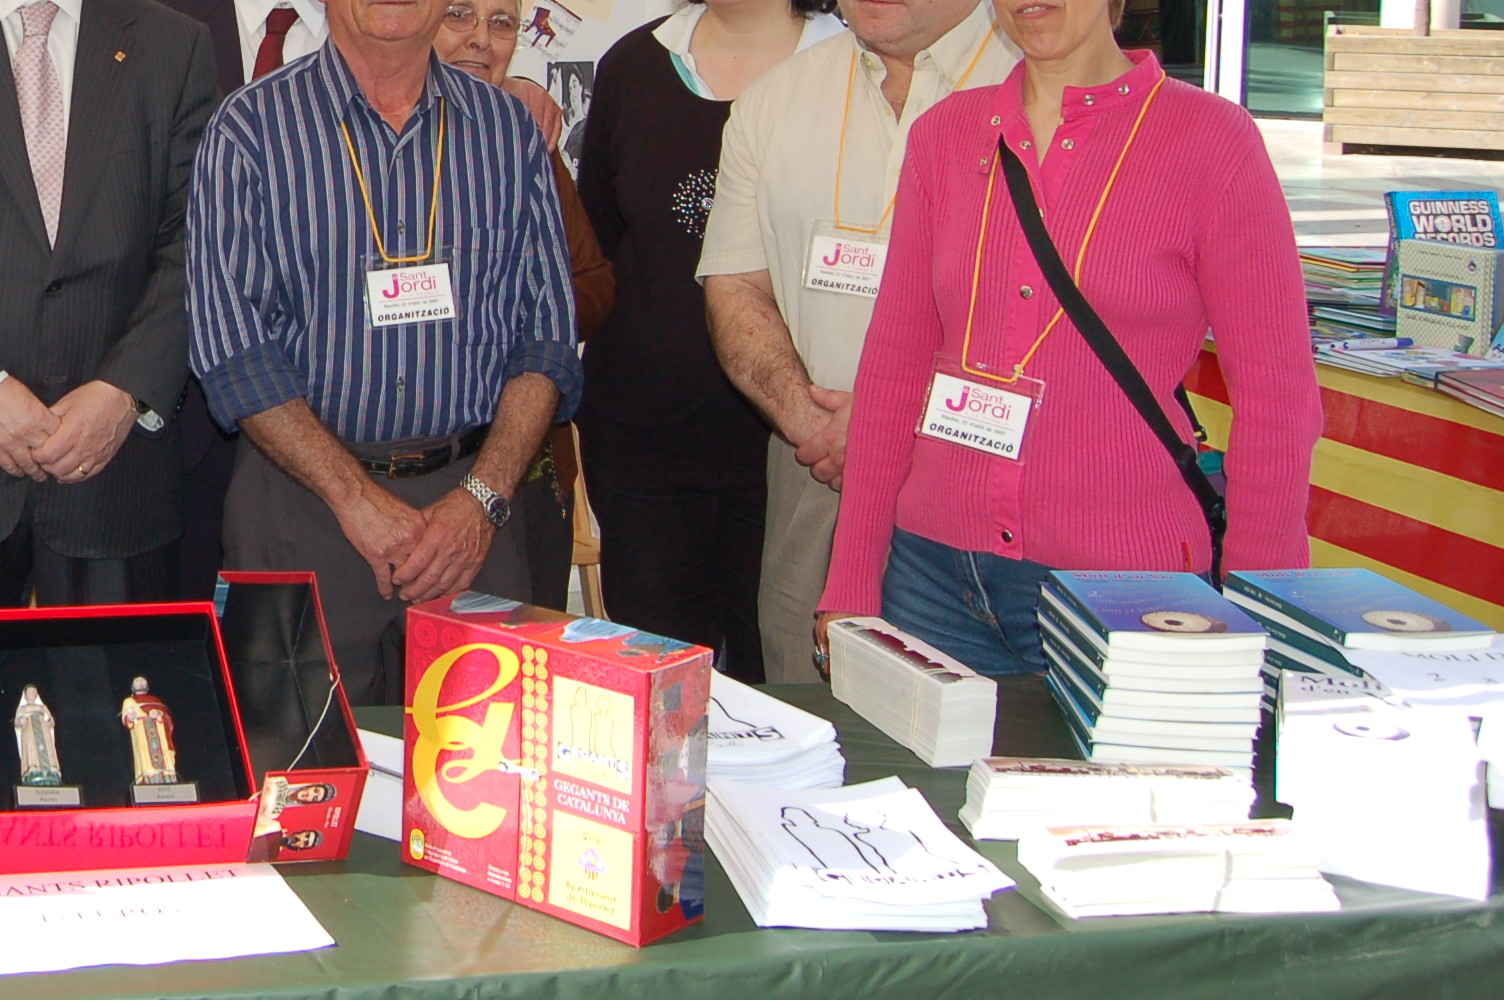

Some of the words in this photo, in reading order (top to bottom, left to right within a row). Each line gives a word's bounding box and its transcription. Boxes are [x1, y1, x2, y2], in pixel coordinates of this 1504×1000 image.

[1408, 200, 1490, 214] GUINNESS
[1411, 214, 1494, 233] WORLD
[822, 242, 876, 268] Jordi
[842, 243, 870, 255] Sant
[382, 273, 437, 299] Jordi
[399, 271, 427, 280] Sant
[945, 385, 1012, 421] Jordi
[970, 387, 1005, 405] Sant
[553, 779, 611, 807] GEGANTS
[612, 796, 631, 814] DE
[557, 792, 627, 825] CATALUNYA
[94, 867, 240, 889] RIPOLLET
